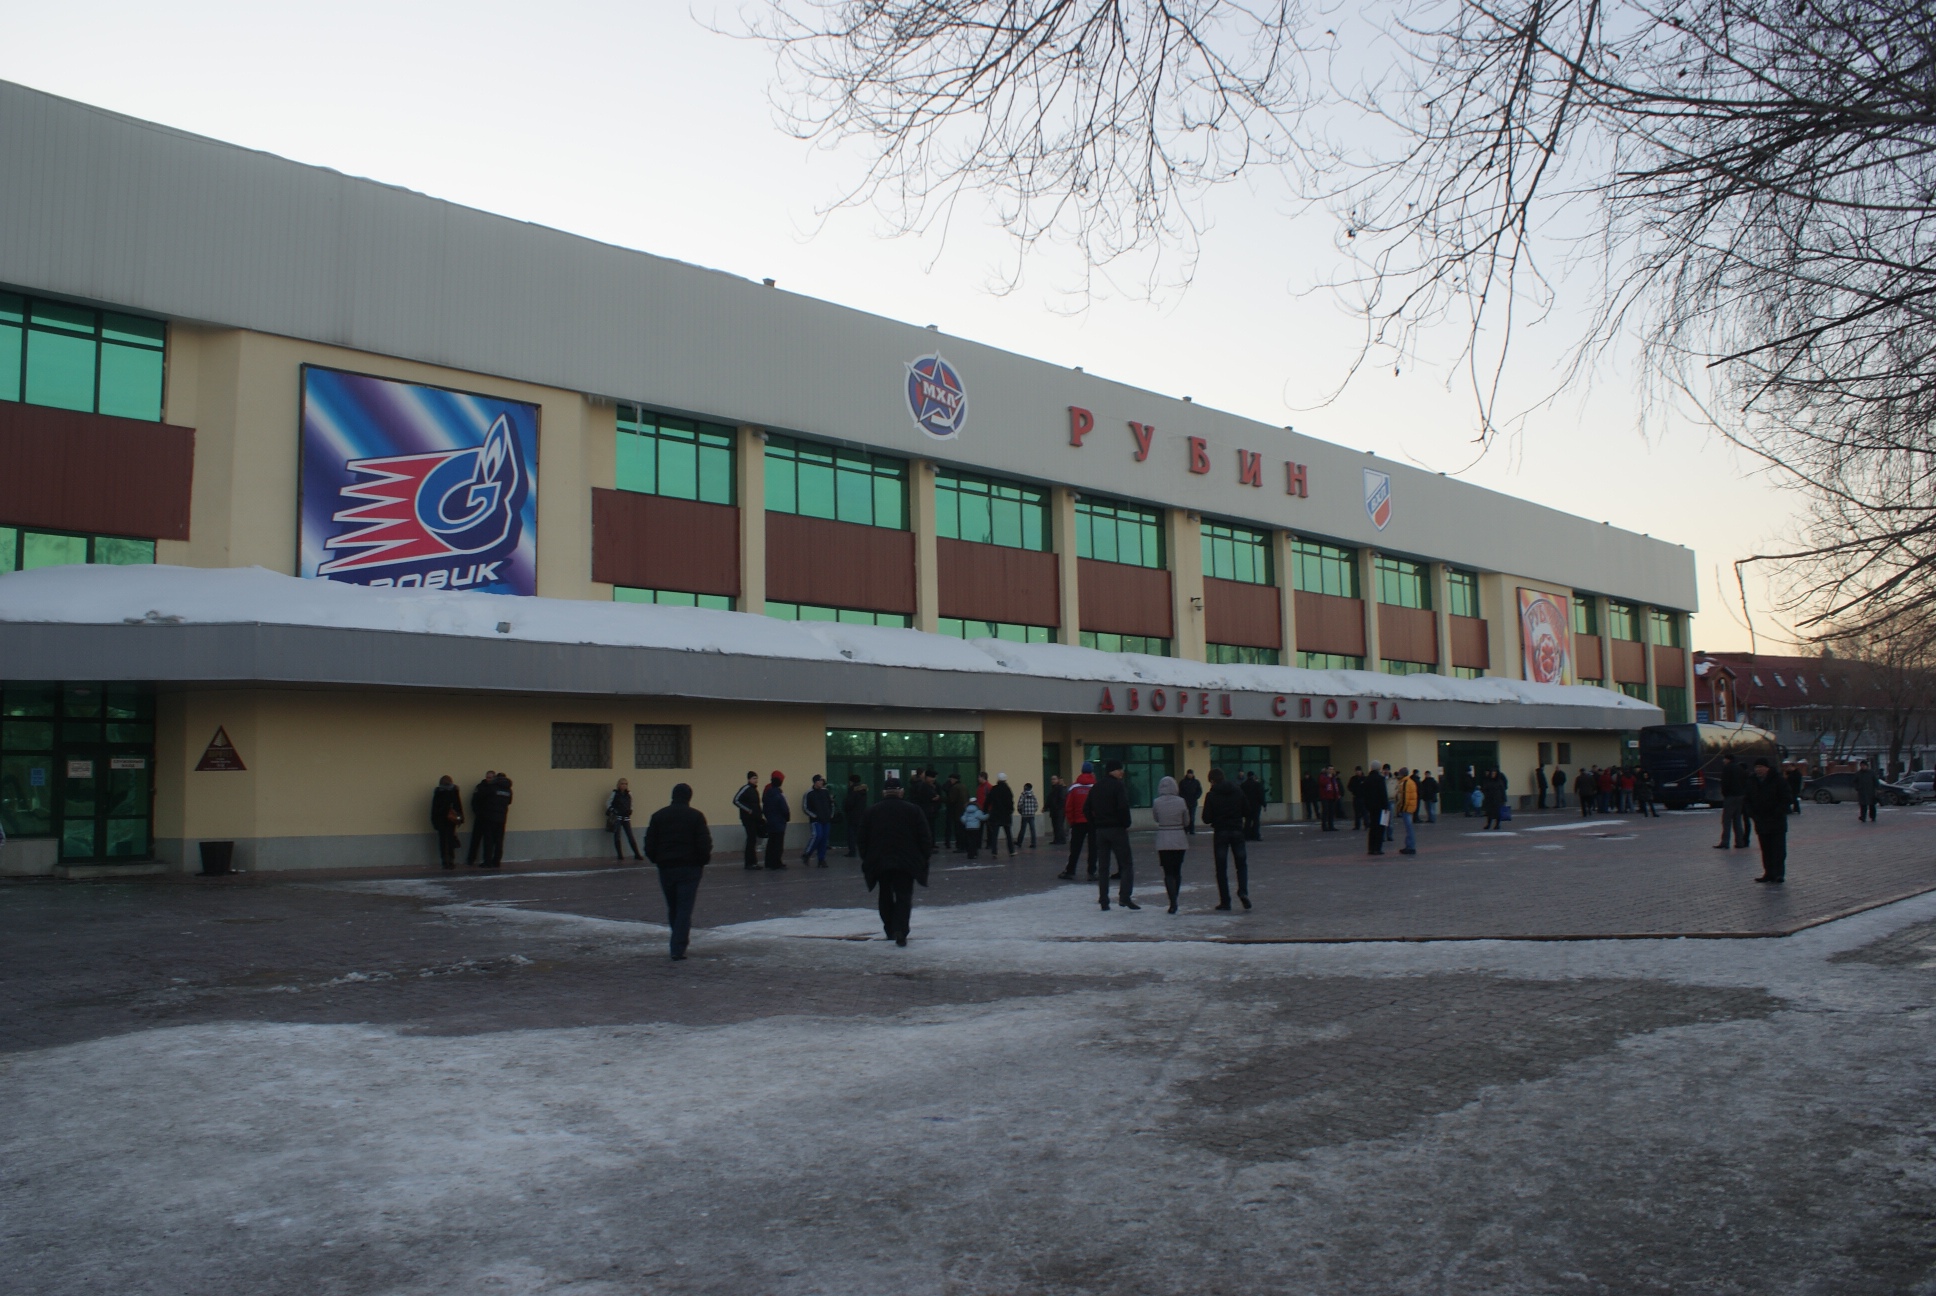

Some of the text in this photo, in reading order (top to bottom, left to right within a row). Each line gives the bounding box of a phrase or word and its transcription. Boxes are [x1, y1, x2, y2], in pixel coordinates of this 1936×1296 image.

[922, 381, 957, 408] МХЛ
[1068, 405, 1308, 499] РУБИН
[1098, 686, 1402, 721] ДВОРЕЦ СПОРТА
